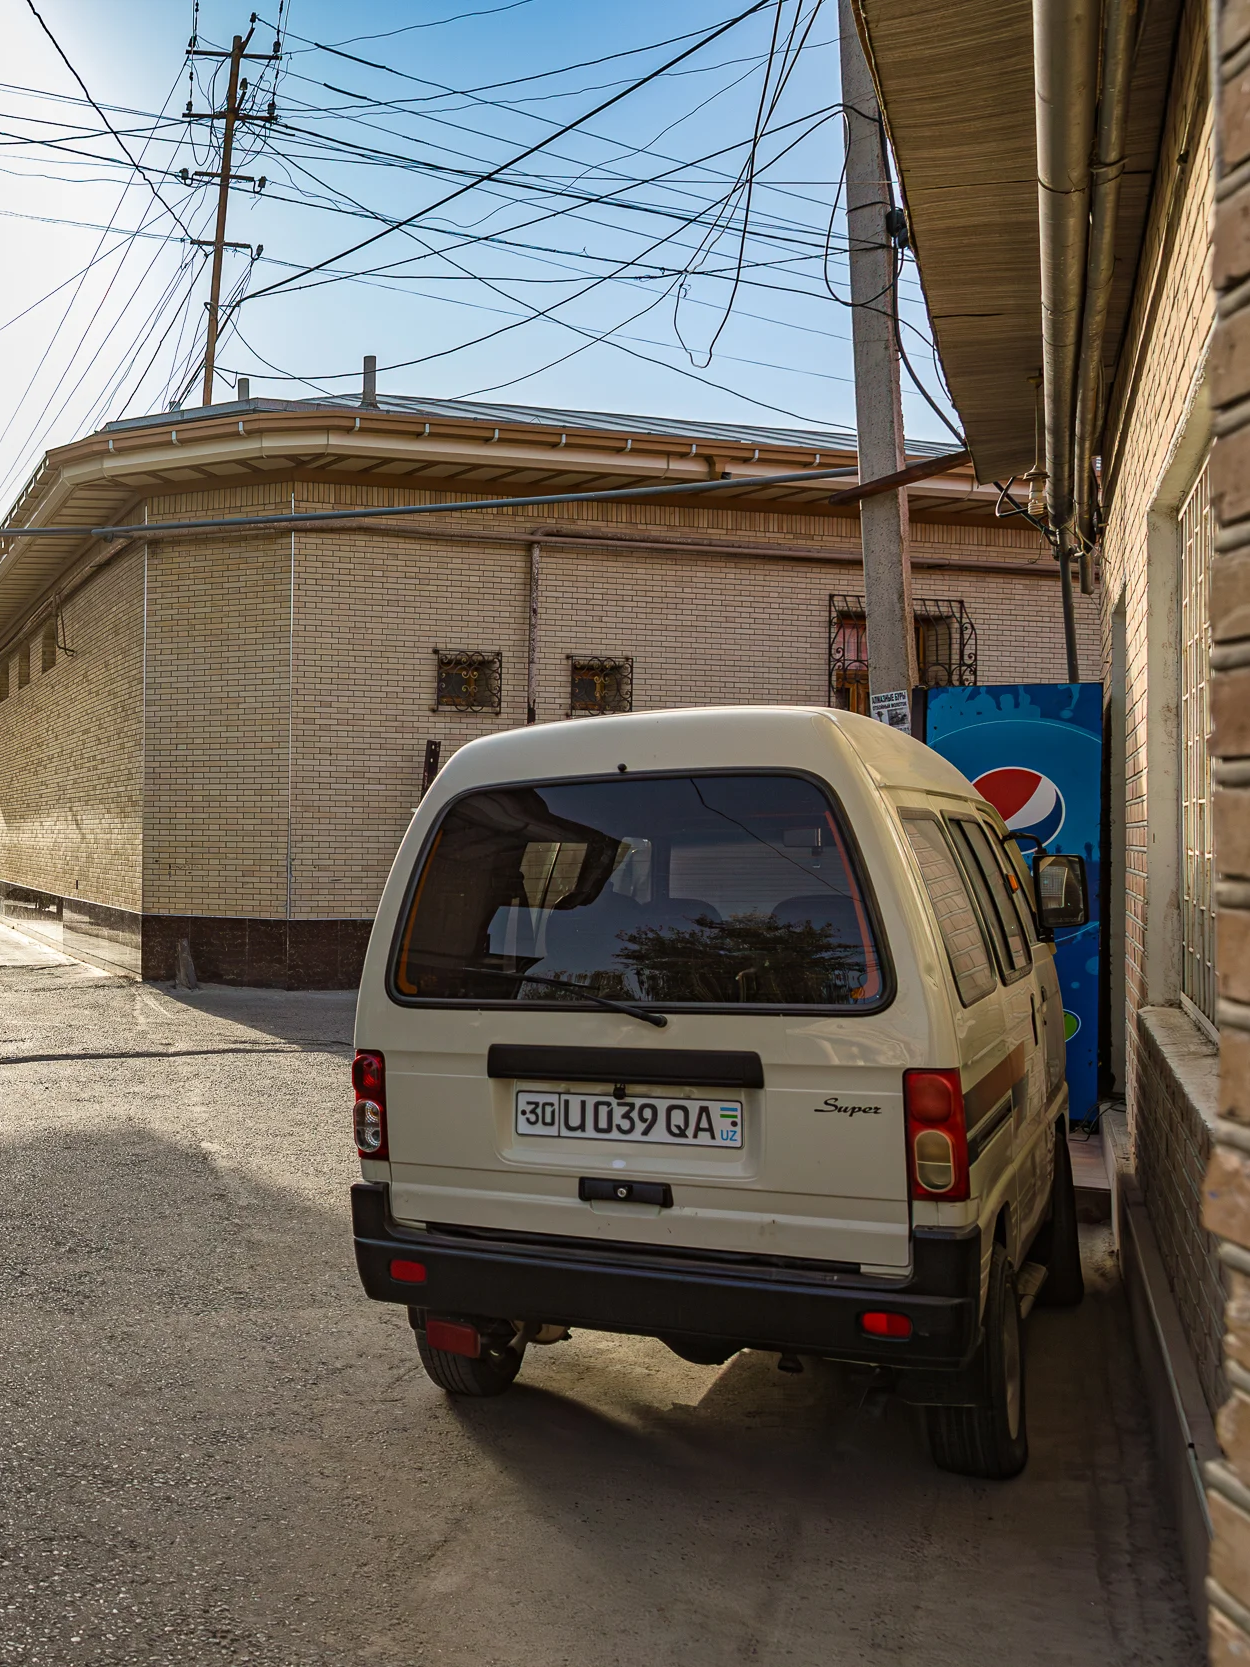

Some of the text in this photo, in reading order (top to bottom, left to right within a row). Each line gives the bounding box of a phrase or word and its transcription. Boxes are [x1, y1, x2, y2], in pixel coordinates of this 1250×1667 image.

[525, 1101, 556, 1127] 30
[813, 1097, 882, 1117] Super
[720, 1129, 738, 1142] UZ
